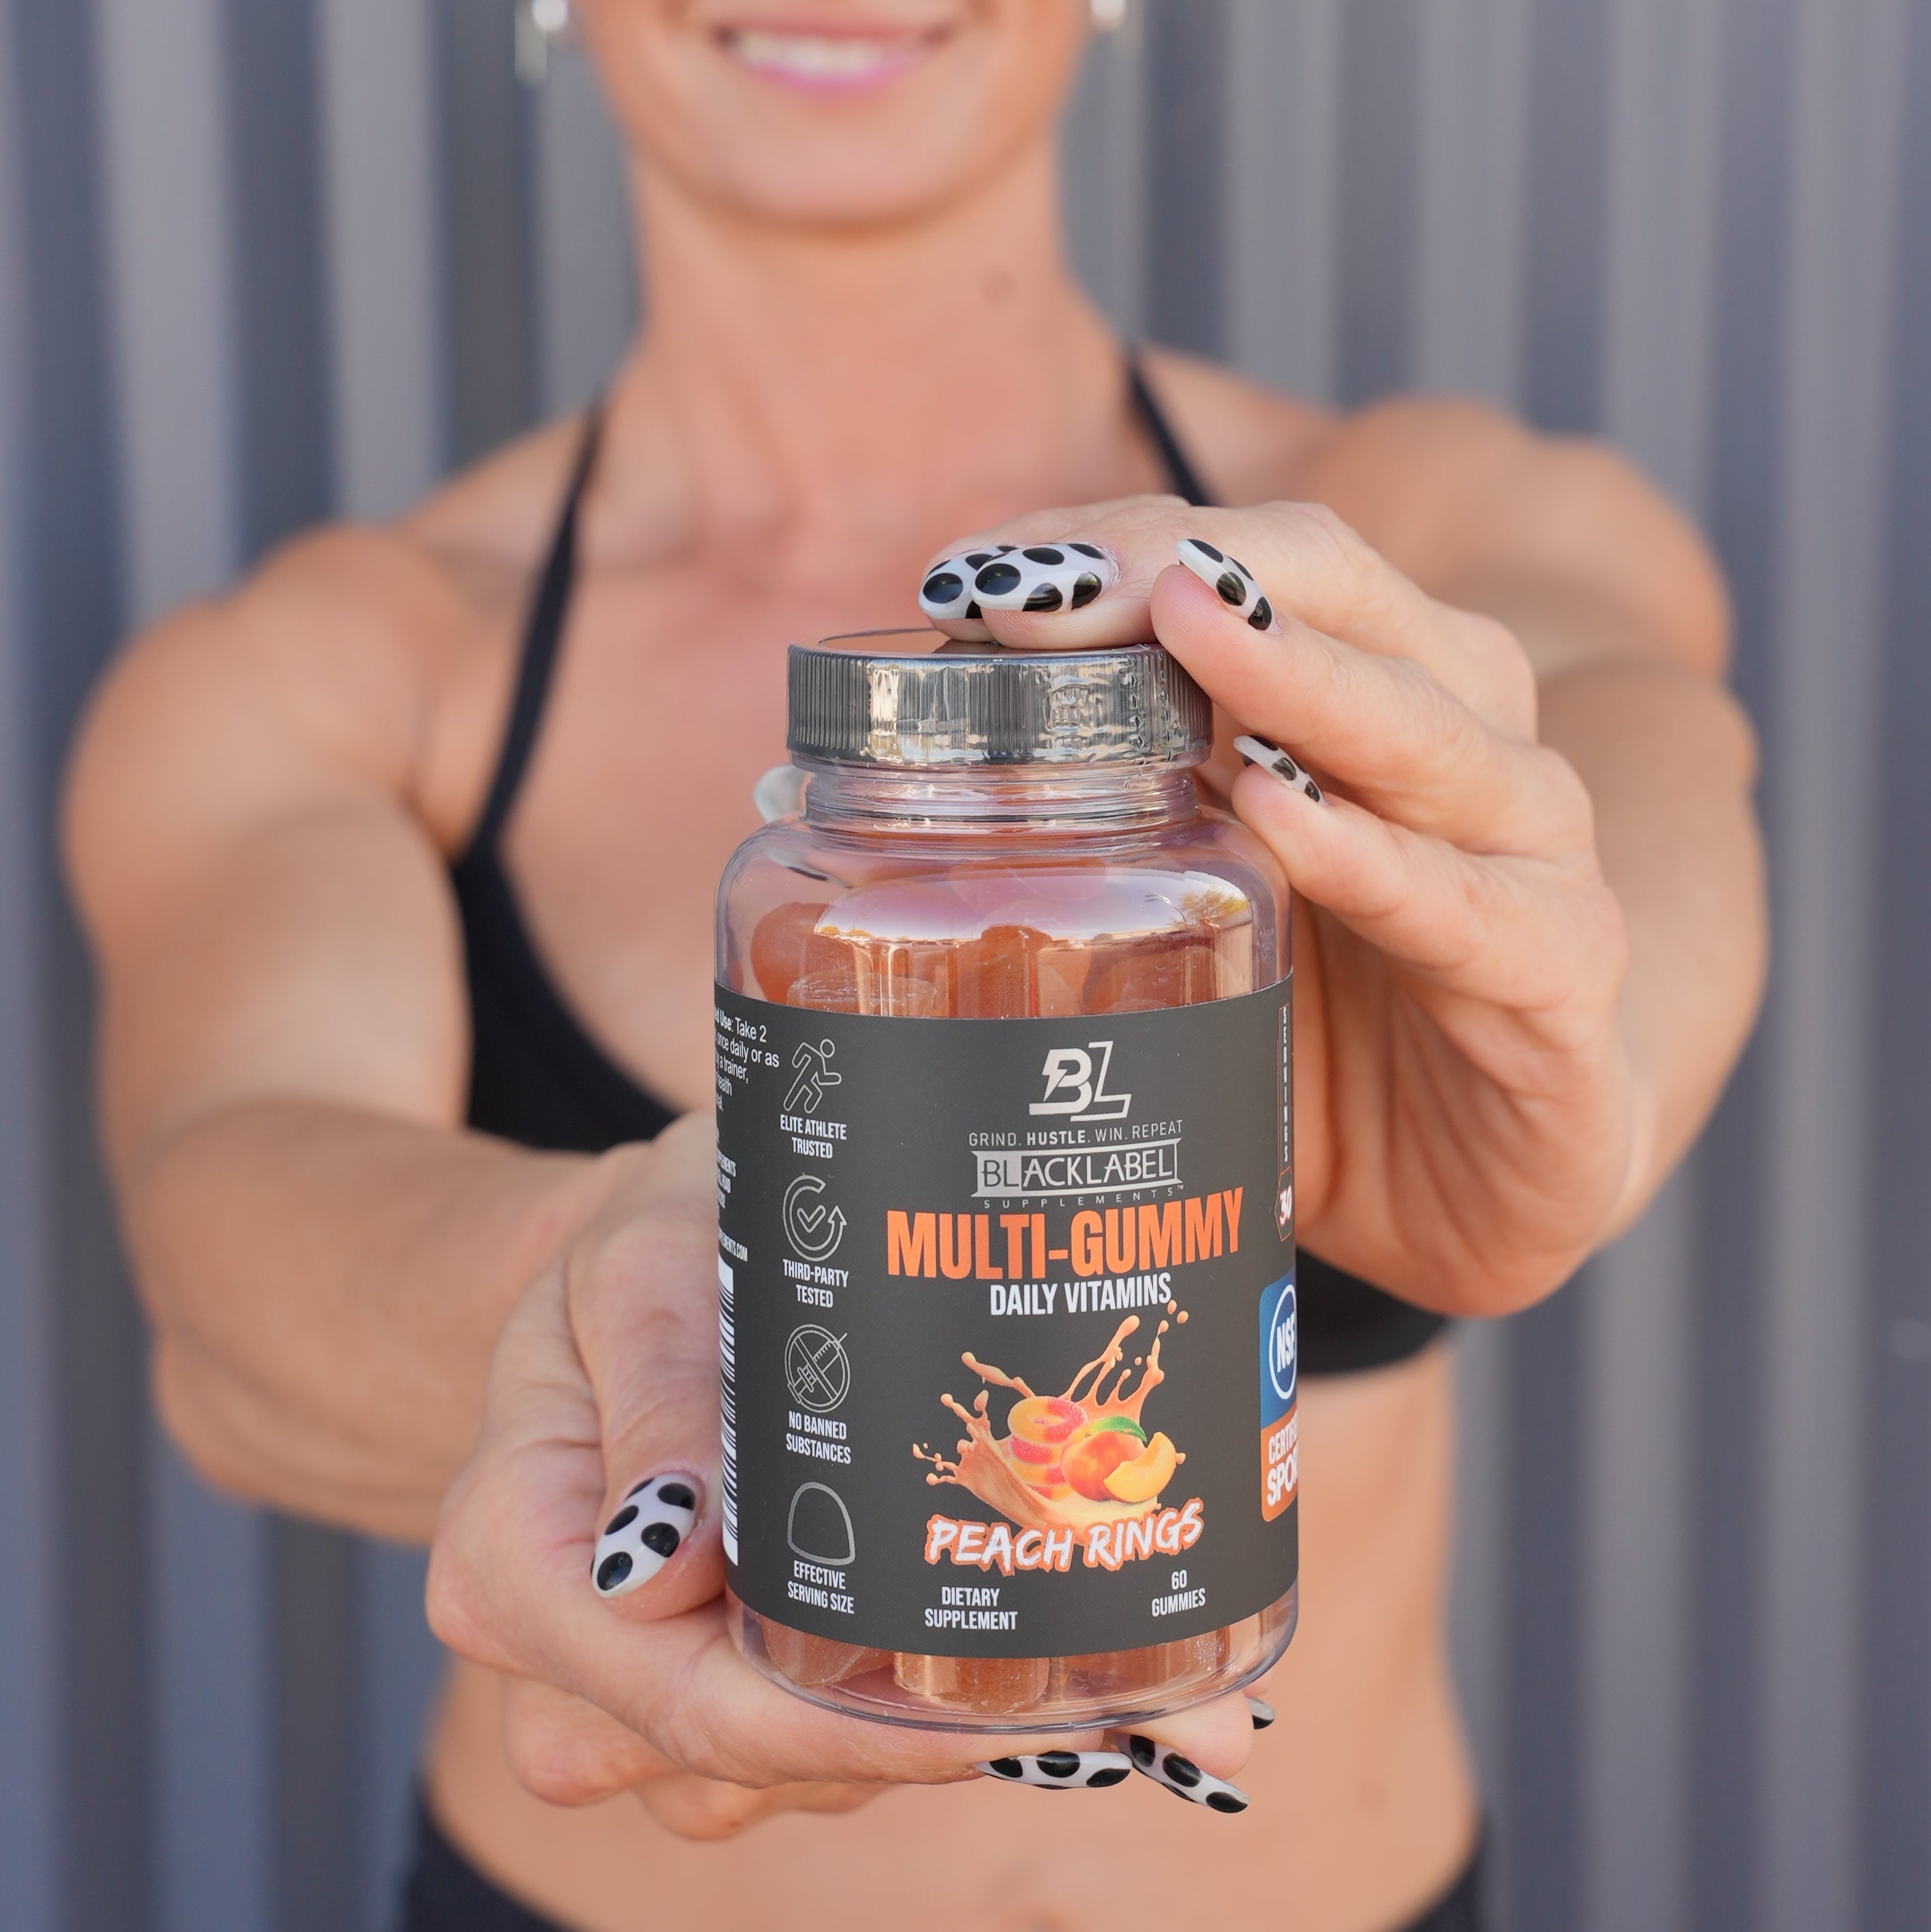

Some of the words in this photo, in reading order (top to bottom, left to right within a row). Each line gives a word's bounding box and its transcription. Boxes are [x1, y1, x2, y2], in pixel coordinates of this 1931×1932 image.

[735, 1016, 757, 1040] Take
[759, 1024, 767, 1043] 2
[730, 1037, 749, 1063] daily
[751, 1048, 762, 1063] or
[764, 1052, 779, 1067] as
[723, 1055, 749, 1084] trainer,
[780, 1114, 805, 1134] ELITE
[805, 1118, 848, 1140] ATHLETE
[969, 1132, 1021, 1146] GRIND.
[1027, 1129, 1091, 1145] HUSTLE.
[1094, 1127, 1128, 1142] WIN.
[1132, 1119, 1183, 1140] REPEAT
[791, 1136, 833, 1159] TRUSTED
[1280, 1185, 1292, 1226] 30
[886, 1186, 1244, 1279] MULTI-GUMMY
[782, 1258, 849, 1288] THIRD-PARTY
[796, 1283, 834, 1308] TESTED
[990, 1283, 1058, 1316] DAILY
[1064, 1272, 1171, 1313] VITAMINS
[1276, 1312, 1294, 1373] NSF
[788, 1410, 802, 1431] NO
[803, 1414, 847, 1440] BANNED
[785, 1433, 851, 1465] SUBSTANCES
[925, 1513, 1076, 1576] PEACH
[1083, 1498, 1204, 1571] RINGS
[793, 1560, 846, 1590] EFFECTIVE
[1171, 1569, 1188, 1590] 60
[787, 1580, 828, 1608] SERVING
[830, 1592, 854, 1614] SIZE
[941, 1586, 1000, 1607] DIETARY
[1151, 1588, 1206, 1617] GUMMIES
[925, 1608, 1018, 1630] SUPPLEMENT
